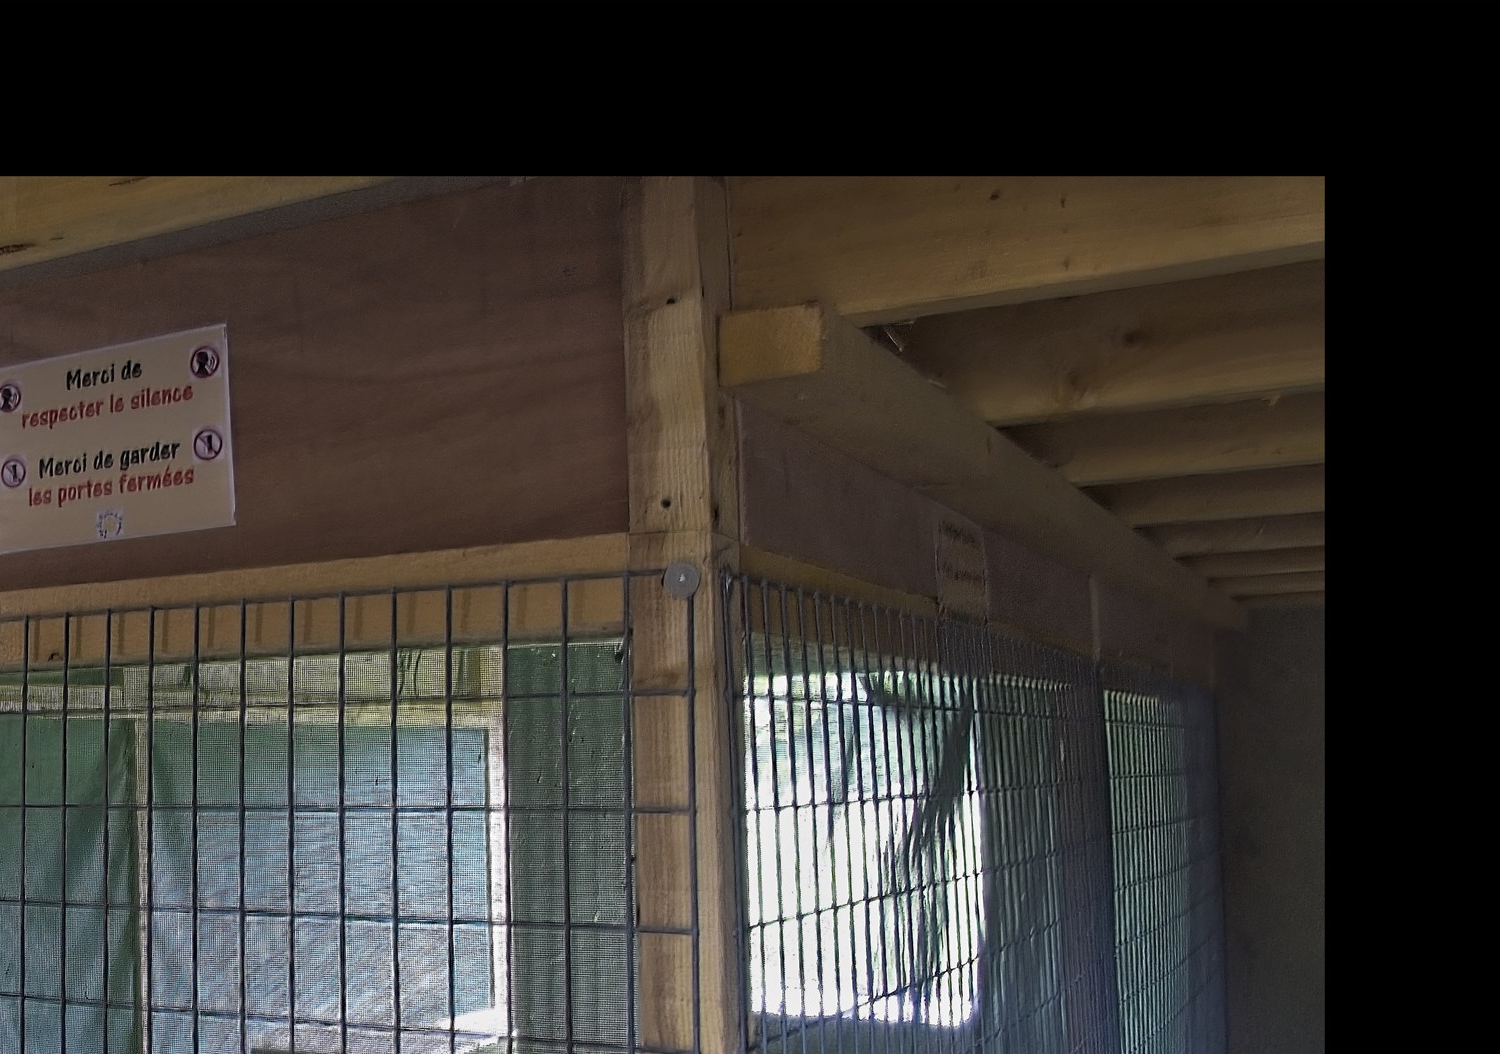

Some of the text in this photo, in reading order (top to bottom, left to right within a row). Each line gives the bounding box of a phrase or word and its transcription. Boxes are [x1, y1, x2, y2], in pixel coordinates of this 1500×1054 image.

[66, 360, 142, 390] Merci de
[21, 384, 193, 429] respecter le silence
[38, 442, 180, 479] Merci de garder
[28, 465, 194, 508] les portes fermées
